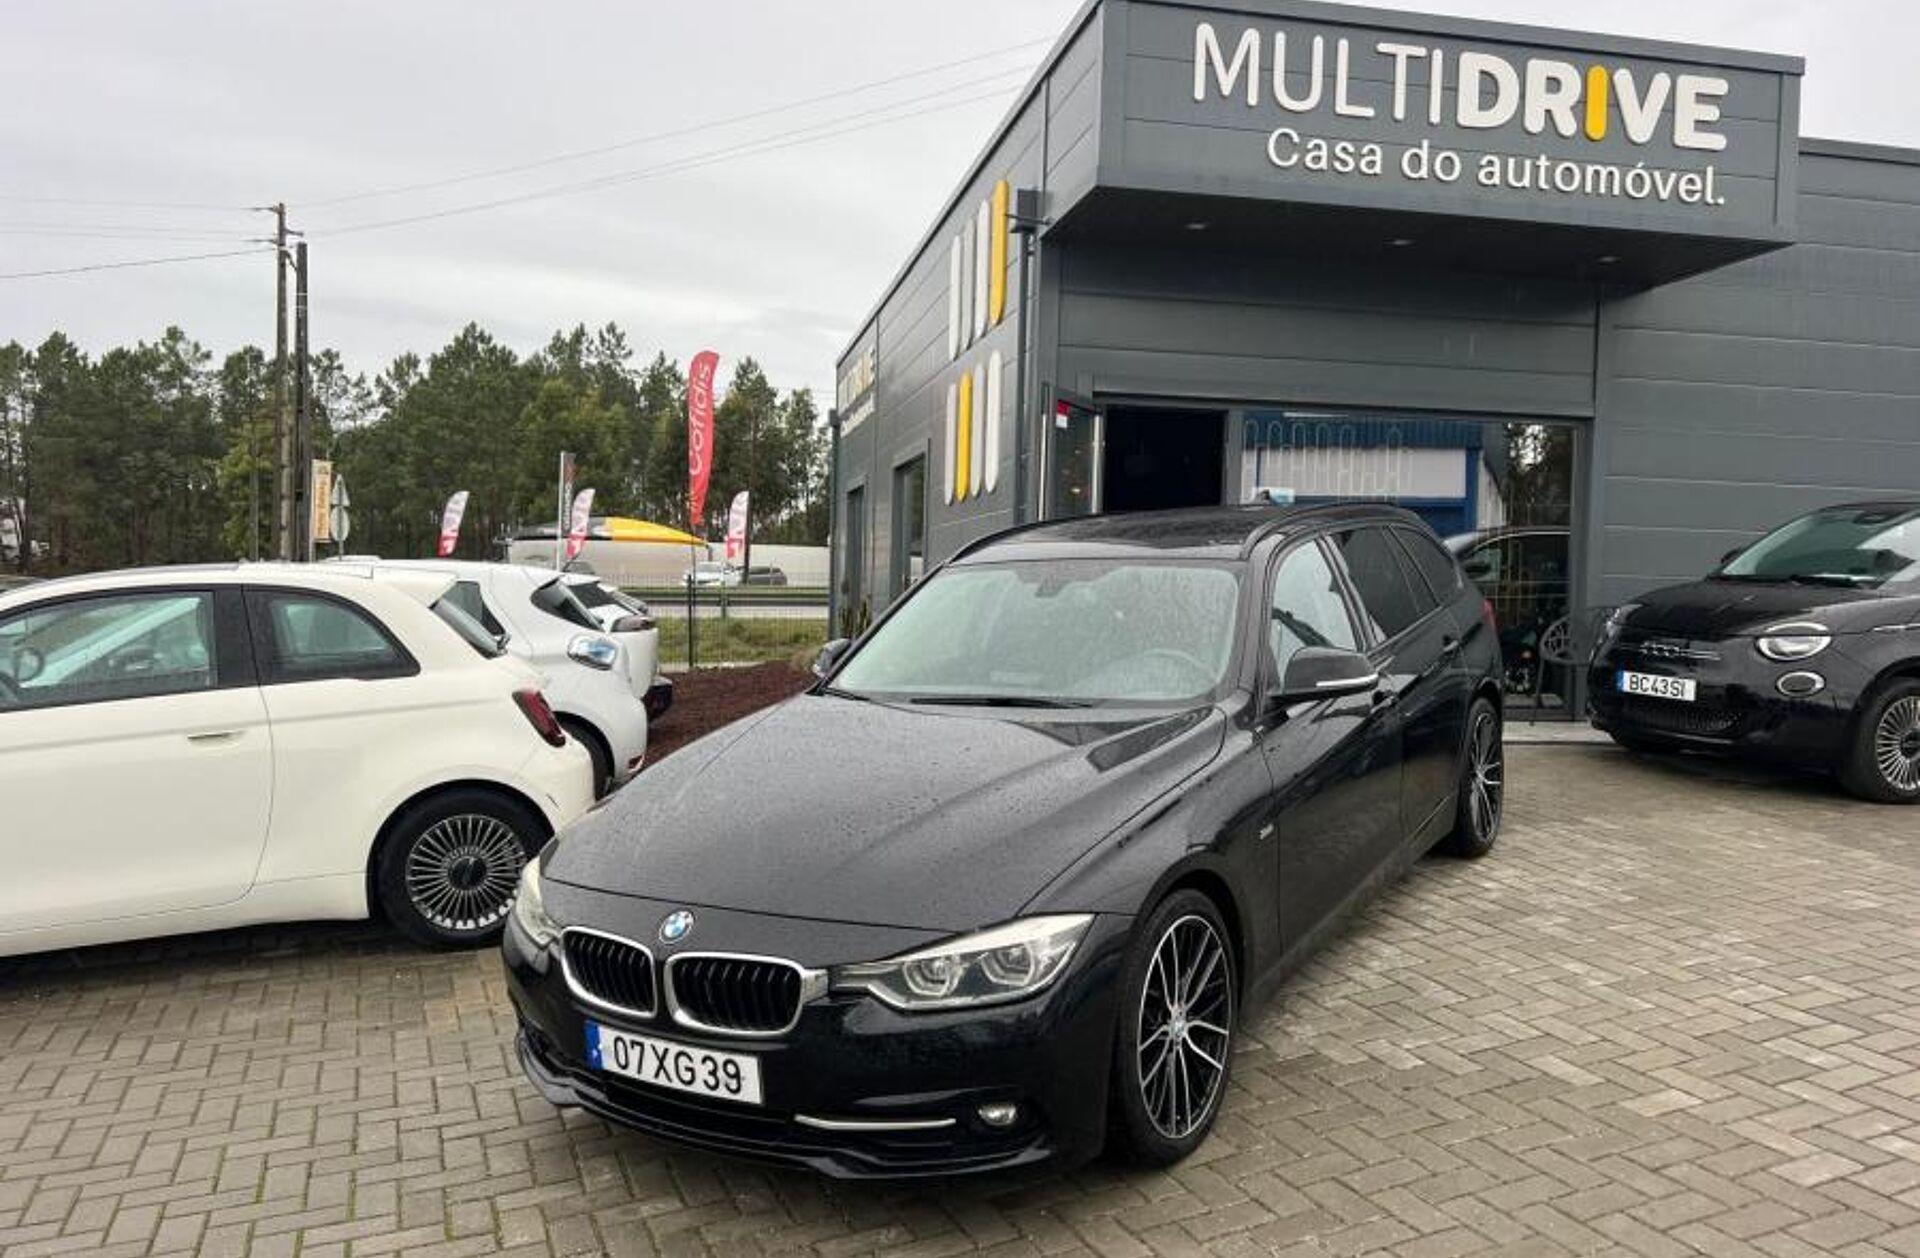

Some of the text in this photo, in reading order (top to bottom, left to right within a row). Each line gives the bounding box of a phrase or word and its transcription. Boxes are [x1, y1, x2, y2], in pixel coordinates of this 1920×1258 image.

[1194, 22, 1729, 151] MULTIDRIVE
[1267, 128, 1725, 205] Casa do automóvel.
[613, 1036, 742, 1095] 07XG39
